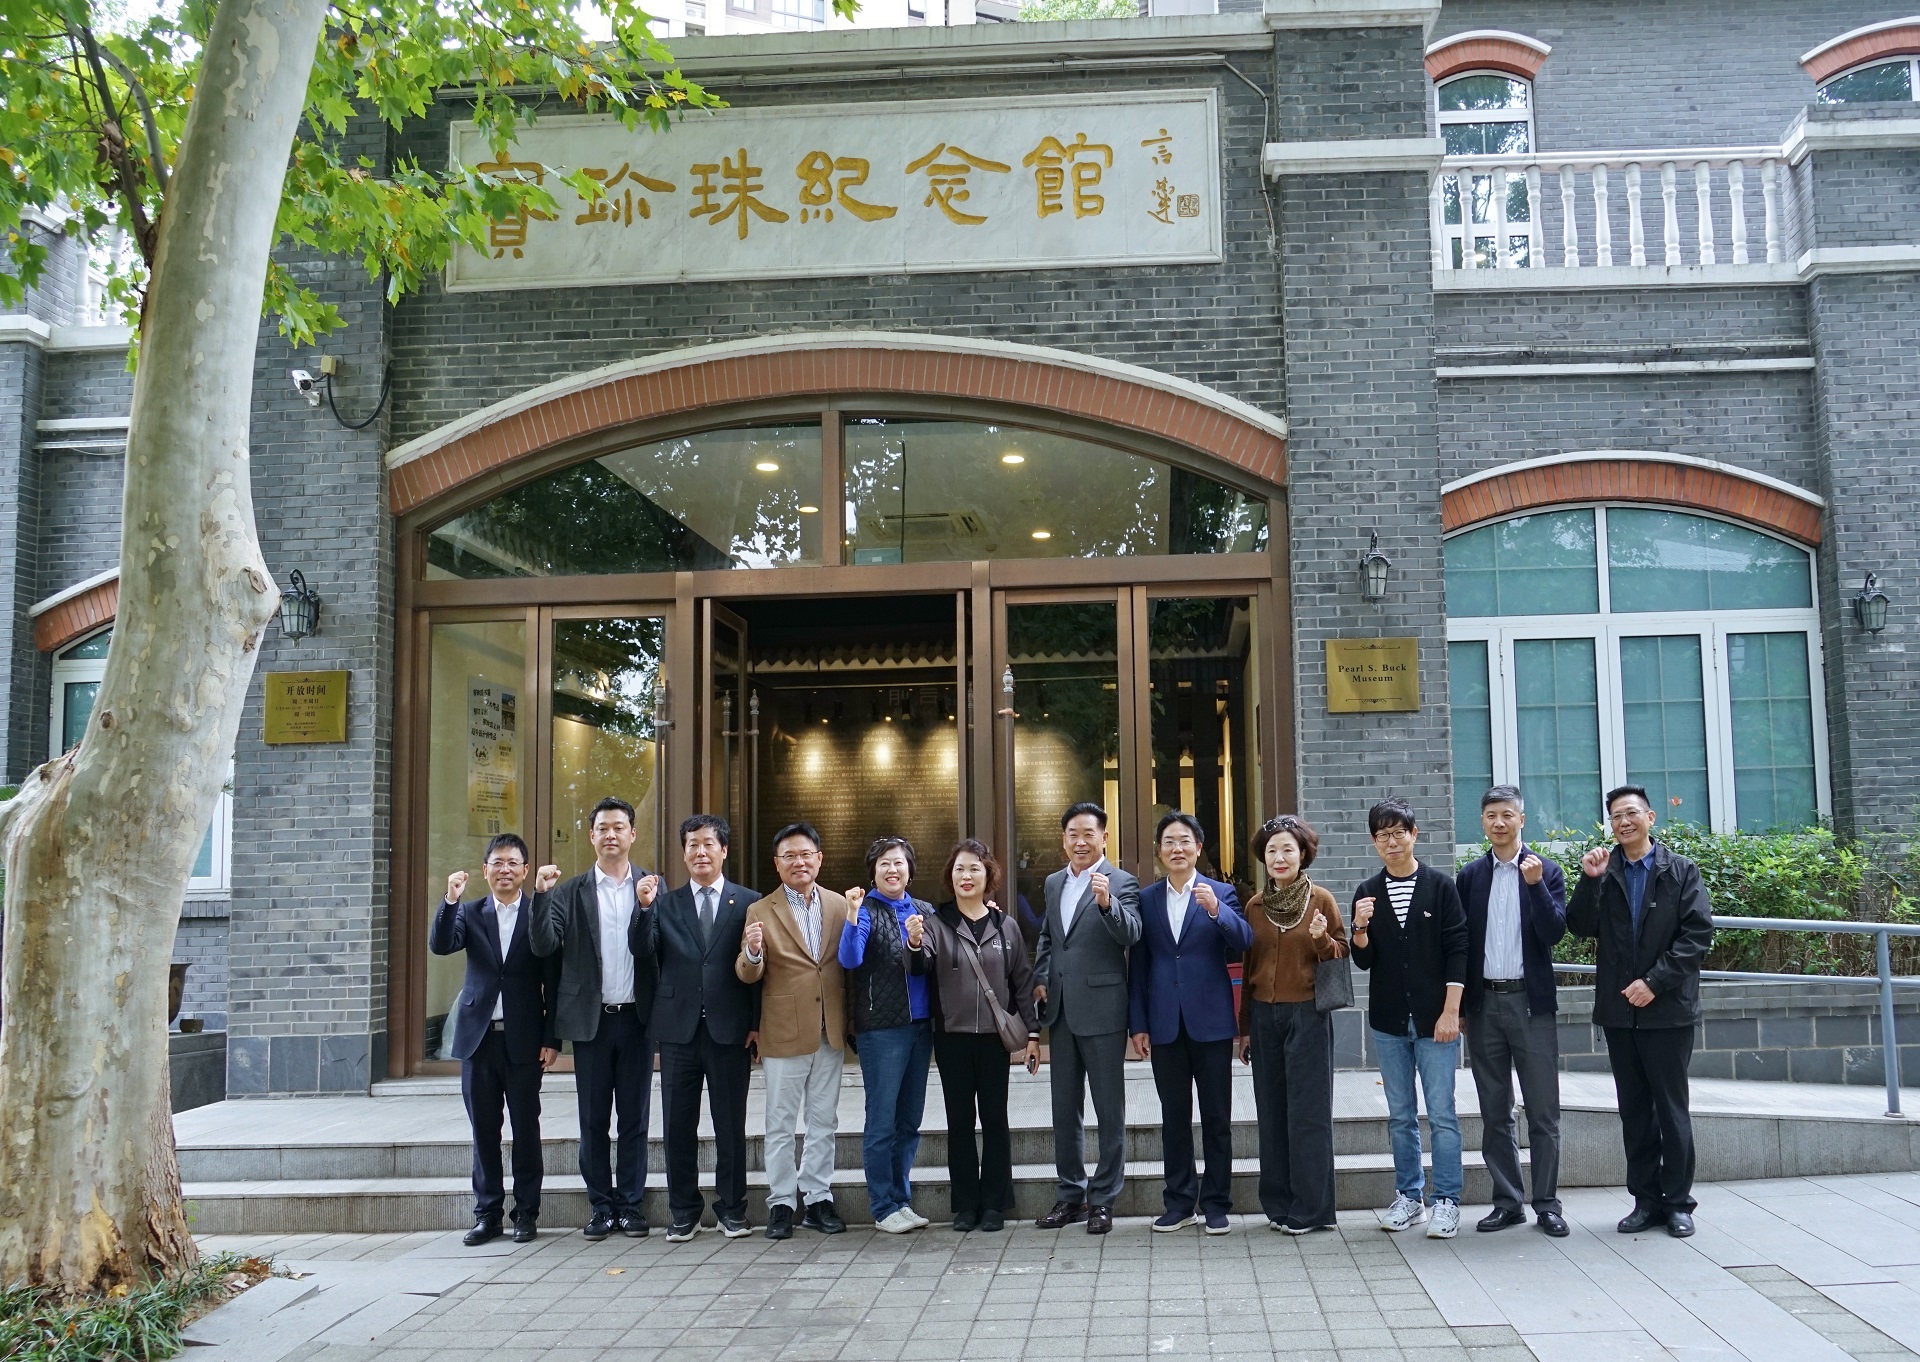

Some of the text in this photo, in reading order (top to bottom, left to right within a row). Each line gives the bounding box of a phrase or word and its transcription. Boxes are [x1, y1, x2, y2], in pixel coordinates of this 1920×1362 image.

[1338, 663, 1407, 673] Pearl S. Buck
[1352, 675, 1393, 683] Museum
[286, 685, 326, 696] 开放时间
